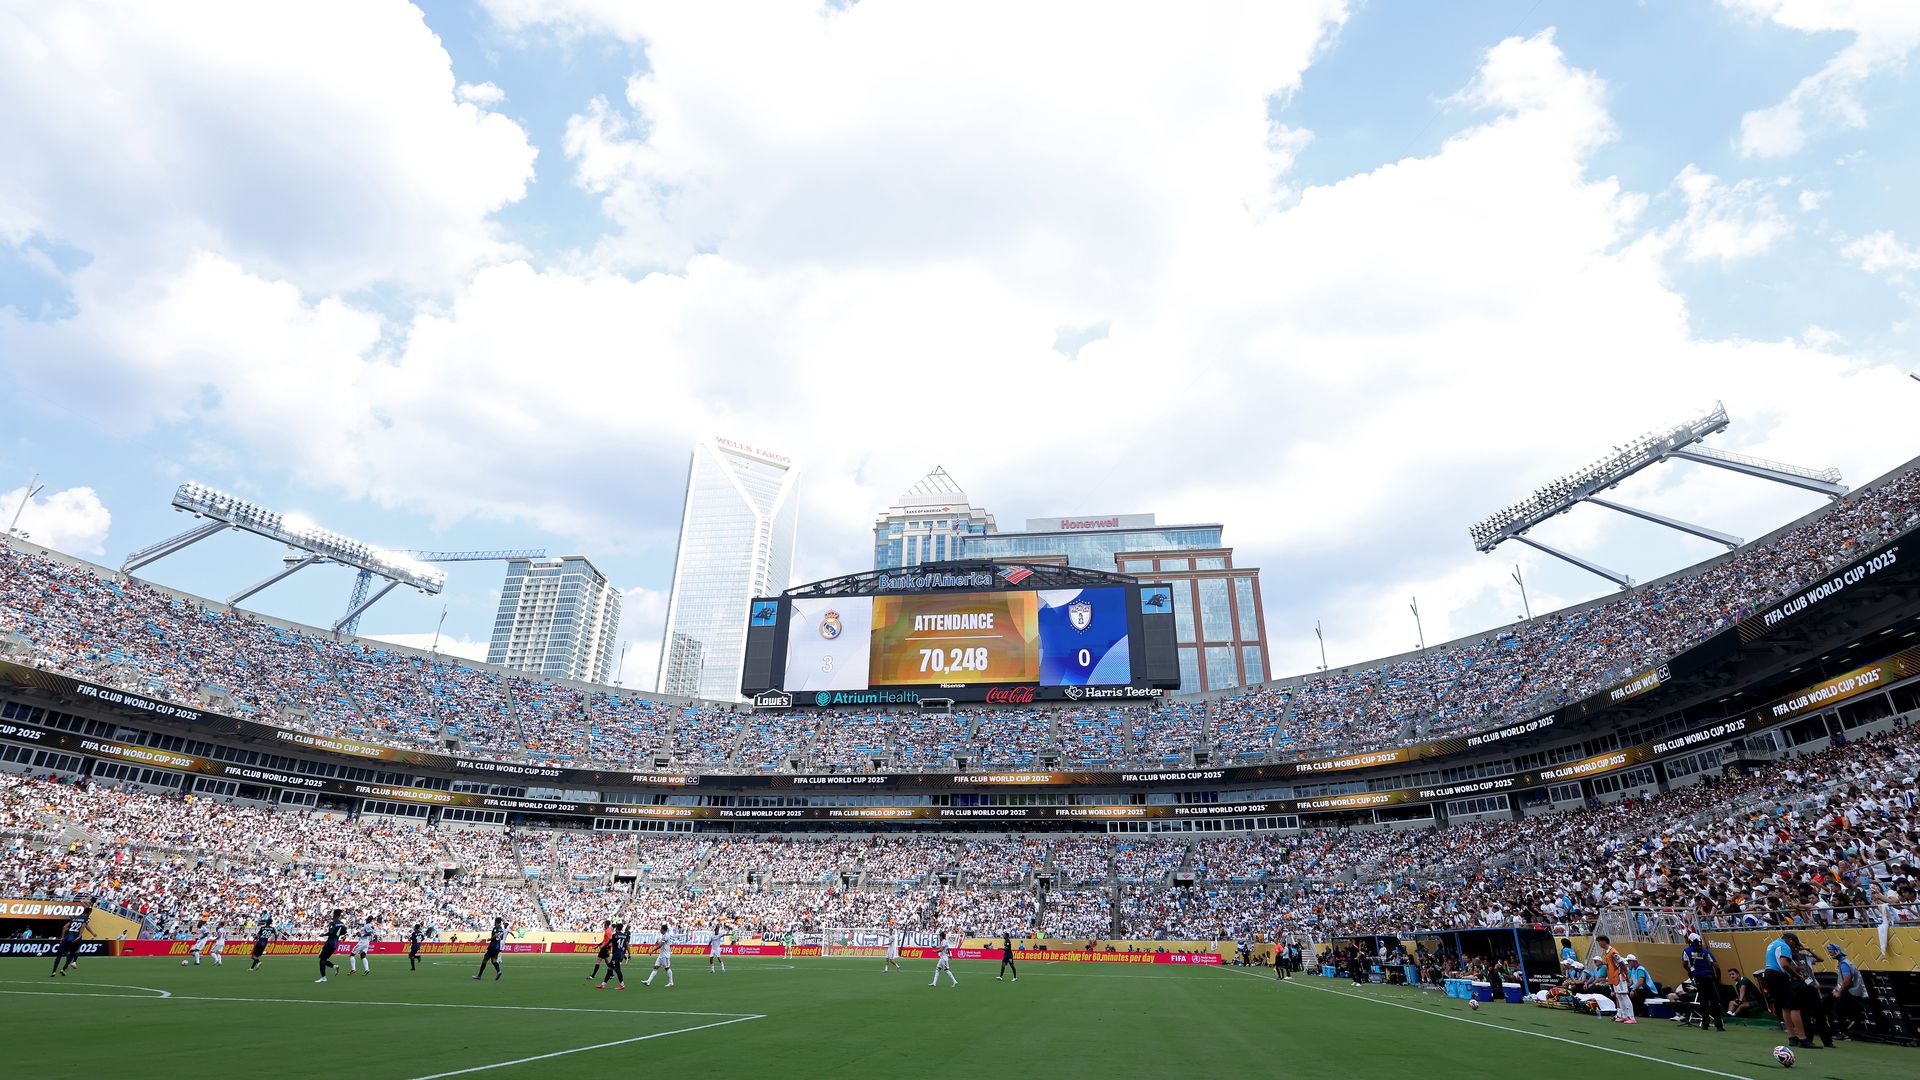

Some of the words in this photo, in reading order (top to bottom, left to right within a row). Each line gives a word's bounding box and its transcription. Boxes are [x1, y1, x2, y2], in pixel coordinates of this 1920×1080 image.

[716, 436, 752, 452] WELLS
[756, 448, 791, 463] FARGO
[1061, 518, 1119, 529] Honeywell
[879, 574, 914, 589] Bank
[916, 574, 932, 588] of
[933, 572, 992, 587] America
[1763, 609, 1784, 626] FIFA
[1783, 596, 1807, 618] CLUB
[1806, 578, 1843, 605] WORLD
[1844, 566, 1865, 584] CUP
[914, 613, 993, 631] ATTENDANCE
[822, 655, 834, 673] 3
[919, 647, 988, 674] 70,248
[1078, 649, 1091, 667] 0
[833, 691, 877, 705] Atrium
[879, 691, 919, 703] Health
[1085, 687, 1124, 697] Harris
[1124, 686, 1163, 697] Teeter
[1610, 688, 1625, 700] FIFA
[1624, 681, 1641, 695] CLUB
[1772, 704, 1789, 716] FIFA
[1788, 696, 1808, 712] CLUB
[1807, 685, 1837, 703] WORLD
[1838, 678, 1854, 692] CUP
[76, 685, 96, 696] FIFA
[98, 690, 122, 702] CLUB
[123, 696, 154, 710] WORLD
[155, 705, 174, 714] CUP
[757, 696, 789, 706] LOWE'S
[276, 731, 292, 740] FIFA
[294, 735, 313, 744] CLUB
[315, 739, 341, 749] WORLD
[343, 744, 359, 752] CUP
[1467, 737, 1482, 746] FIFA
[1482, 732, 1499, 742] CLUB
[1499, 726, 1525, 738] WORLD
[1526, 721, 1537, 731] CUP
[1653, 743, 1668, 753] FIFA
[1667, 738, 1684, 750] CLUB
[1684, 731, 1709, 744] WORLD
[1710, 726, 1724, 737] CUP
[80, 741, 98, 750] FIFA
[100, 744, 121, 754] CLUB
[122, 749, 152, 760] WORLD
[153, 754, 170, 763] CUP
[496, 765, 523, 773] WORLD
[1313, 762, 1332, 770] CLUB
[1333, 758, 1360, 767] WORLD
[1361, 756, 1375, 764] CUP
[1540, 771, 1555, 780] FIFA
[1555, 767, 1573, 777] CLUB
[1573, 762, 1596, 773] WORLD
[1596, 759, 1608, 768] CUP
[224, 767, 240, 775] FIFA
[242, 770, 260, 778] CLUB
[262, 773, 287, 782] WORLD
[1420, 790, 1435, 798] FIFA
[1436, 788, 1453, 796] CLUB
[1454, 784, 1478, 793] WORLD
[1479, 782, 1493, 790] CUP
[10, 904, 42, 915] CLUB
[43, 905, 85, 916] WORLD
[69, 921, 82, 932] 22
[763, 931, 787, 942] CDMX
[1708, 940, 1732, 949] Hisense
[12, 943, 51, 953] WORLD
[169, 942, 188, 954] Kids
[337, 944, 350, 952] FIFA
[1025, 952, 1042, 960] need
[1042, 952, 1050, 960] to
[1050, 952, 1059, 960] be
[1059, 952, 1081, 961] active
[1082, 952, 1092, 961] for
[1092, 953, 1100, 961] 60
[1101, 953, 1129, 962] minutes
[1129, 954, 1142, 963] per
[1142, 954, 1155, 963] day
